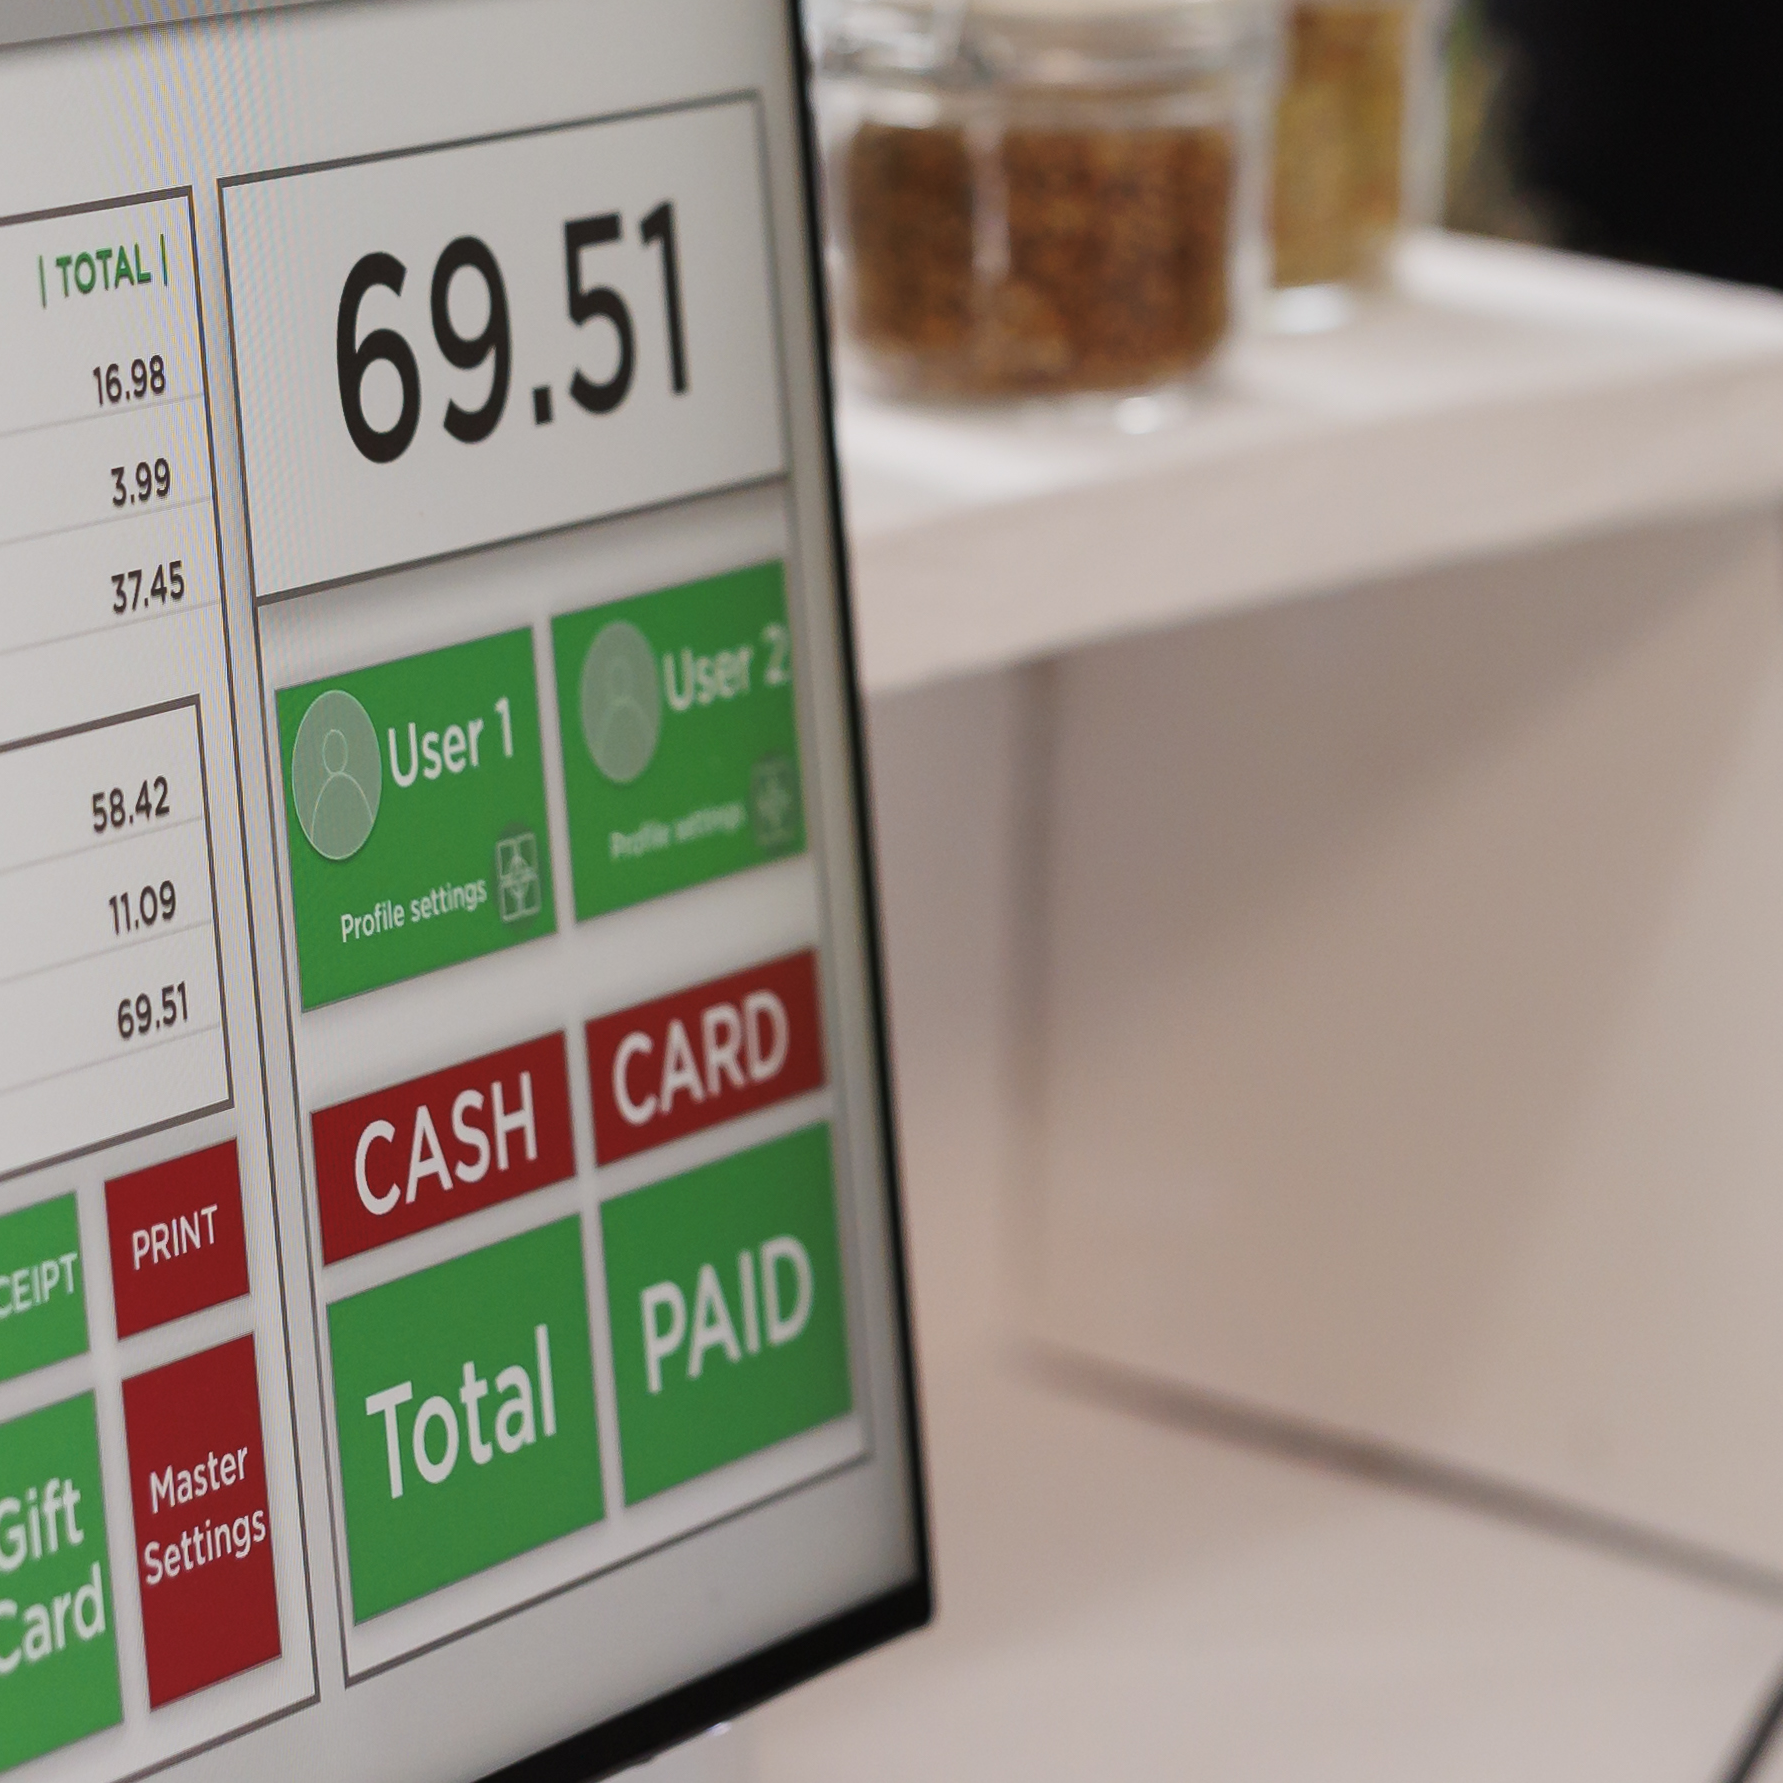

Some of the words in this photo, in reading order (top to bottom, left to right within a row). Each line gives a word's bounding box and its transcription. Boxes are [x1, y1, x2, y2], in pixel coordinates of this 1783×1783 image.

[55, 242, 152, 298] TOTAL
[336, 198, 689, 465] 69.51
[92, 354, 166, 406] 16.98
[110, 457, 171, 508] 3.99
[111, 559, 185, 615] 37.45
[662, 643, 755, 713] User
[763, 622, 793, 688] 2
[387, 716, 485, 788] User
[495, 694, 515, 758] 1
[92, 775, 170, 834] 58.42
[109, 879, 177, 936] 11.09
[340, 894, 406, 943] Profile
[410, 877, 488, 922] settings
[117, 980, 189, 1040] 69.51
[612, 989, 791, 1128] CARD
[354, 1071, 538, 1216] CASH
[132, 1204, 219, 1270] PRINT
[640, 1234, 814, 1395] PAID
[365, 1323, 558, 1500] Total
[150, 1445, 249, 1514] Master
[144, 1508, 268, 1585] Settings
